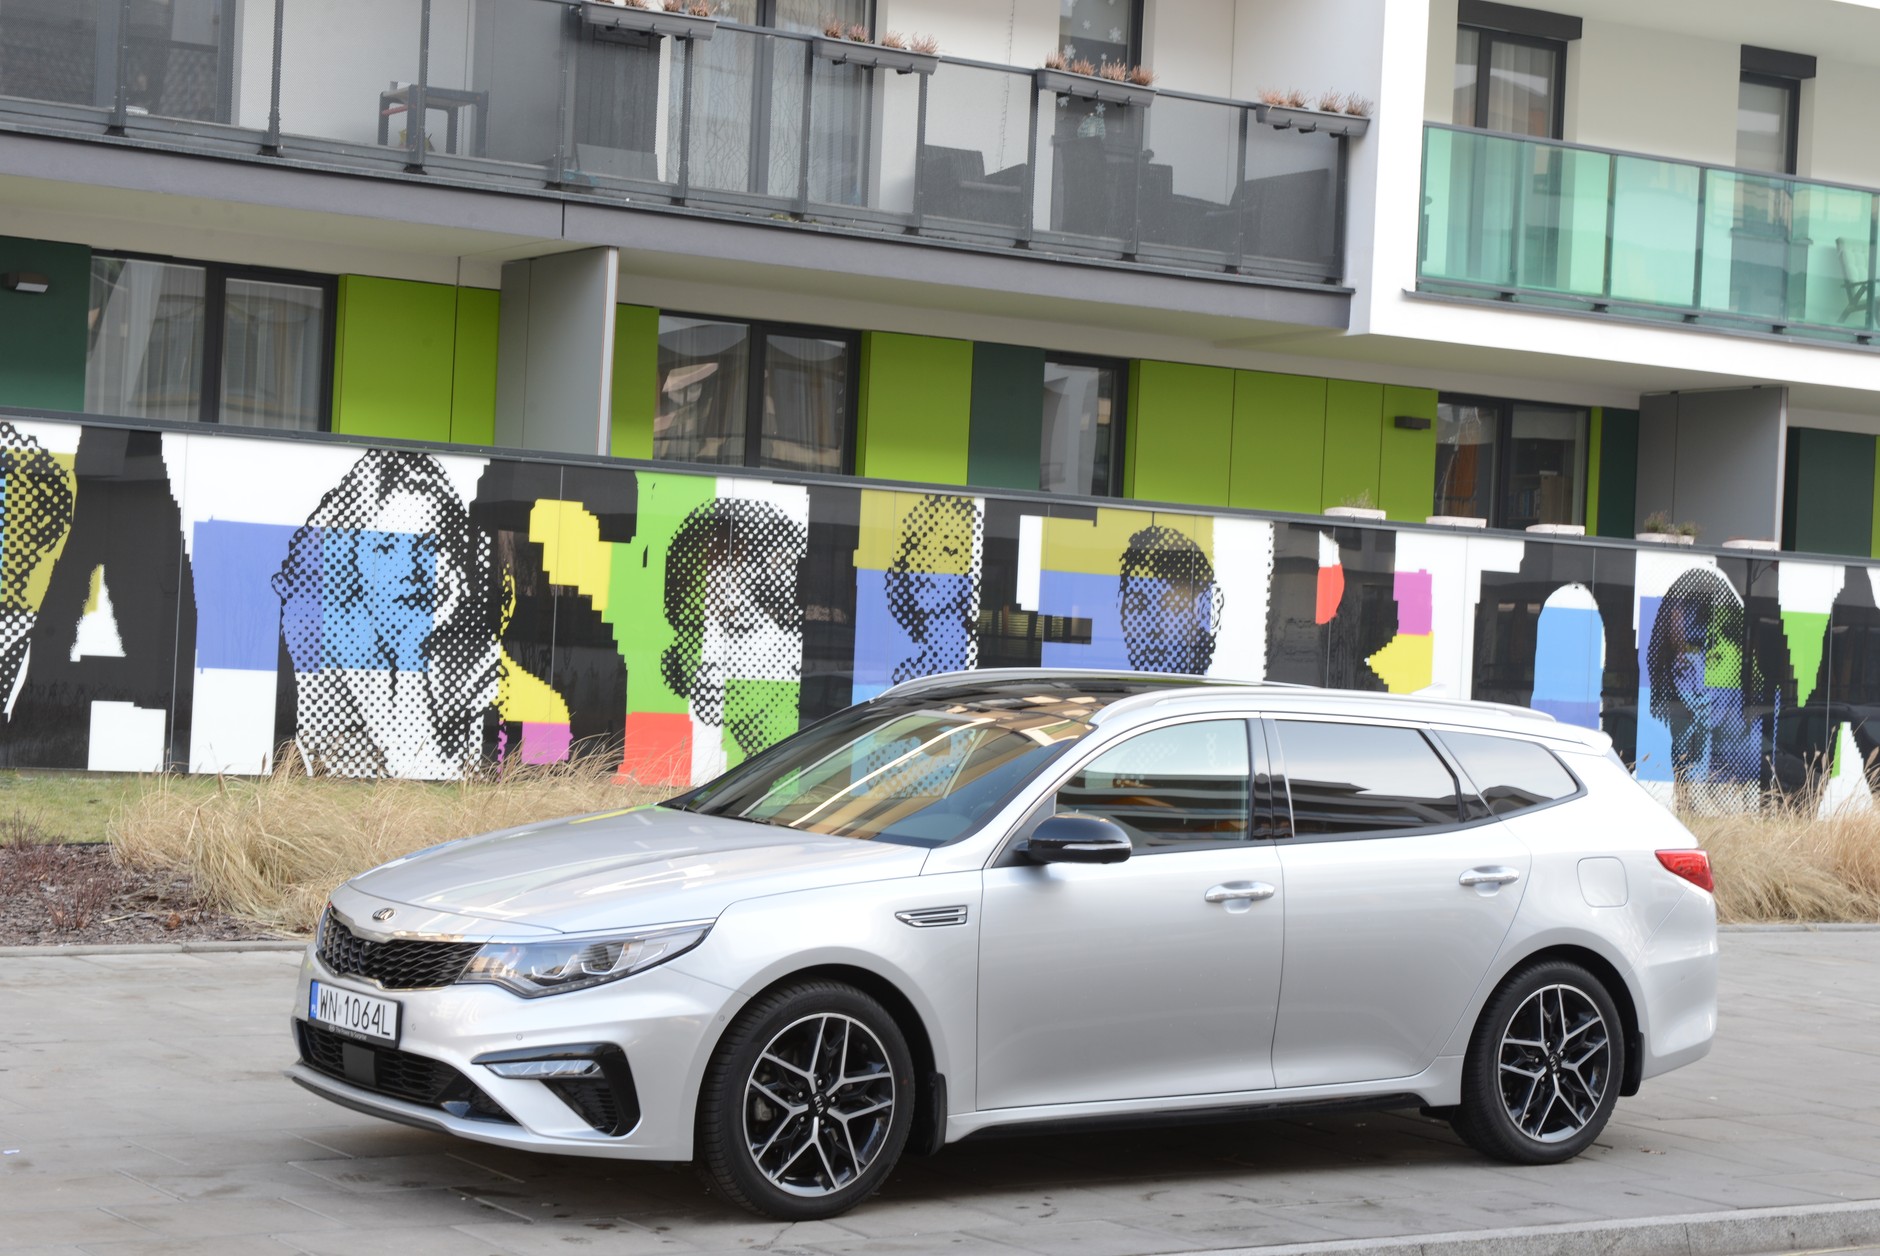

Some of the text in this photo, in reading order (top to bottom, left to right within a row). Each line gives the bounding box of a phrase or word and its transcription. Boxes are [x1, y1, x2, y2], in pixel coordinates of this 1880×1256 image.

[319, 988, 390, 1036] WN 1064L
[813, 1095, 824, 1114] KIA
